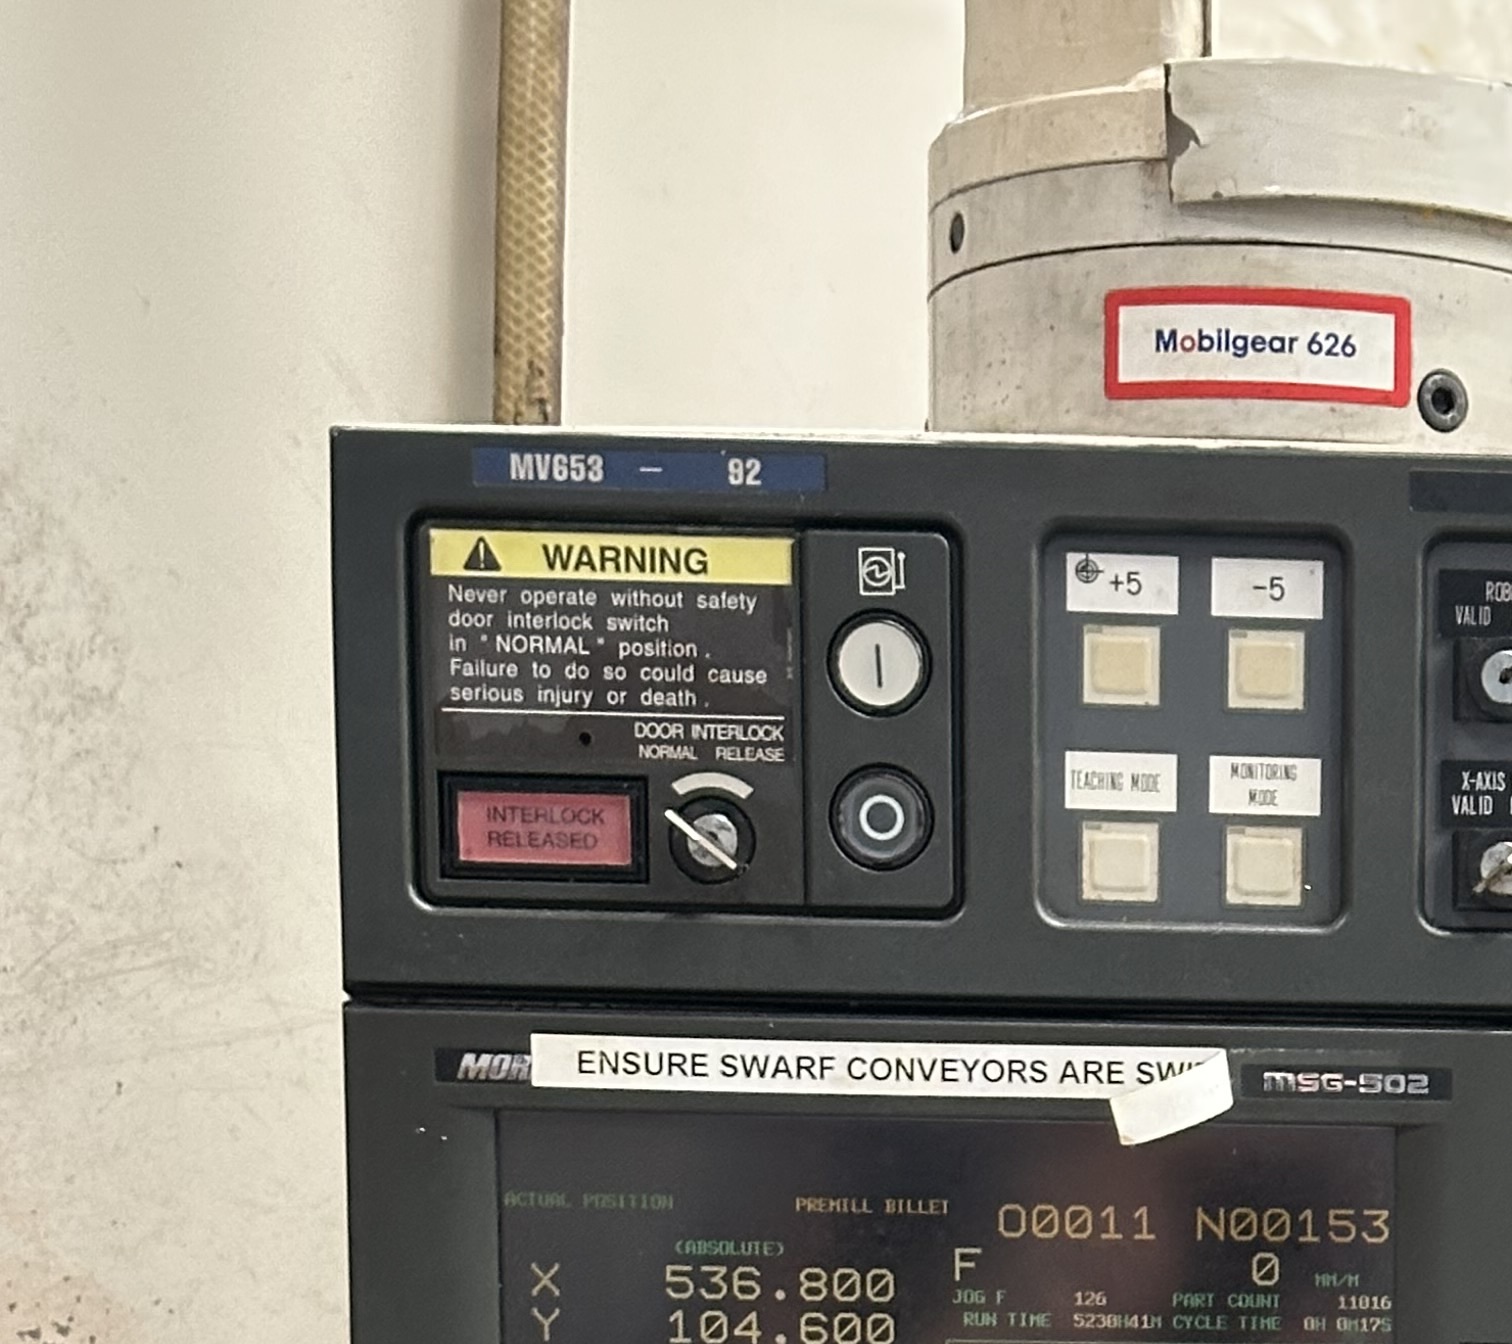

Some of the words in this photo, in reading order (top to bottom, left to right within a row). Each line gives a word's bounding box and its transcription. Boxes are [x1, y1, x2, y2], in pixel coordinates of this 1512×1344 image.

[1155, 328, 1298, 357] Mobilgear
[1307, 332, 1356, 357] 626
[510, 454, 604, 482] MV653
[728, 458, 762, 485] 92
[542, 544, 709, 575] WARNING
[1109, 572, 1142, 595] +5
[448, 585, 507, 604] Never
[521, 588, 596, 611] operate
[611, 590, 682, 608] without
[697, 591, 757, 614] safety
[448, 610, 493, 627] door
[507, 611, 593, 630] interlock
[606, 613, 669, 632] switch
[1455, 606, 1490, 625] VALID
[448, 634, 467, 652] in
[450, 659, 518, 677] Failure
[532, 661, 551, 678] to
[564, 661, 589, 680] do
[604, 665, 626, 680] so
[640, 663, 694, 681] could
[708, 669, 767, 684] cause
[450, 683, 524, 703] serious
[538, 685, 593, 708] injury
[606, 690, 627, 705] or
[634, 722, 683, 739] DOOR
[692, 724, 784, 741] INTERLOCK
[639, 744, 697, 759] NORMAL
[715, 746, 784, 762] RELEASE
[1071, 770, 1124, 792] TEACHING
[1131, 771, 1160, 793] MODE
[1231, 762, 1297, 781] MONITORING
[1462, 771, 1505, 791] X-AXIS
[1248, 789, 1278, 807] MODE
[1452, 795, 1493, 815] VALID
[486, 807, 605, 824] INTERLOCK
[487, 831, 597, 849] RELEASED
[578, 1051, 708, 1077] ENSURE
[721, 1054, 835, 1079] SWARF
[847, 1057, 1048, 1085] CONVEYORS
[1060, 1061, 1124, 1085] ARE
[505, 1192, 570, 1207] ACTUAL
[583, 1194, 673, 1209] POSITION
[796, 1199, 872, 1214] PREMILL
[885, 1199, 948, 1215] BILLET
[1196, 1207, 1389, 1243] N00153
[954, 1248, 982, 1281] F
[530, 1263, 560, 1297] X
[665, 1266, 895, 1301] 536.800
[1173, 1293, 1217, 1308] PART
[1228, 1293, 1280, 1308] COUNT
[531, 1307, 560, 1341] Y
[964, 1313, 997, 1327] RUN
[1008, 1313, 1051, 1328] TIME
[1173, 1315, 1227, 1330] CYCLE
[1239, 1316, 1282, 1331] TIME
